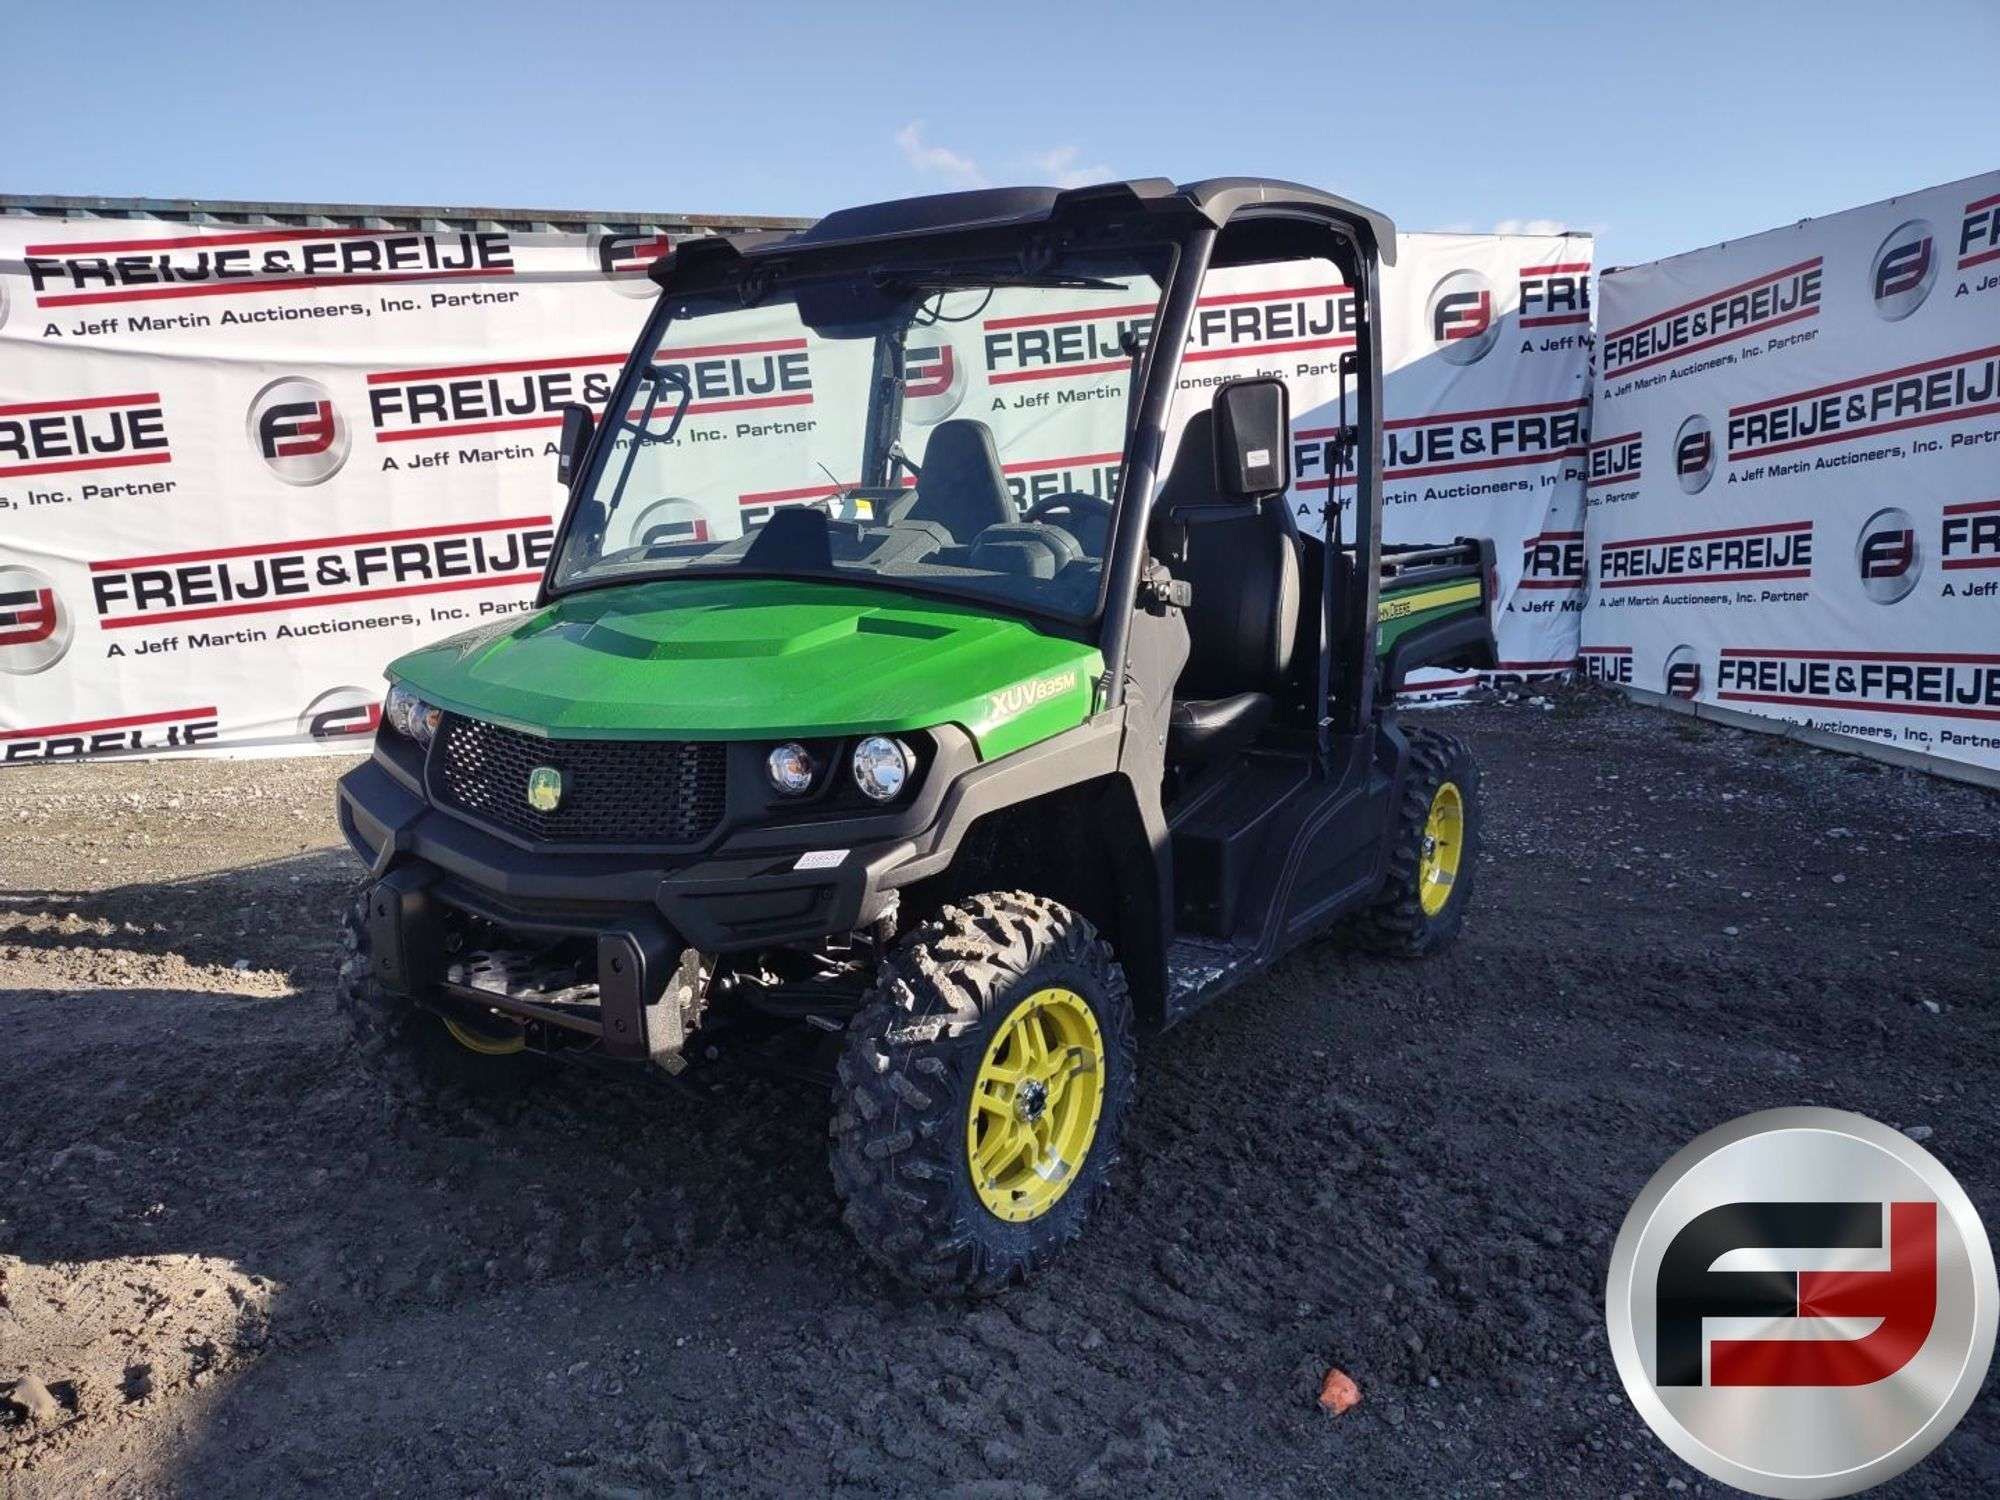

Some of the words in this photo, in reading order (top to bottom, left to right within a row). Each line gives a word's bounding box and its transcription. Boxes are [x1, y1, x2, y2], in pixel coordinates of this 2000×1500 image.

[24, 249, 254, 291] FREIJE
[302, 233, 514, 274] FREIJE
[1955, 283, 1969, 298] A
[43, 322, 63, 338] A
[72, 319, 119, 337] Jeff
[128, 312, 210, 333] Martin
[220, 303, 371, 325] Auctioneers,
[380, 298, 421, 313] Inc.
[431, 290, 519, 309] Partner
[1604, 315, 1688, 370] FREIJE
[1711, 269, 1822, 334] FREIJE
[1520, 340, 1534, 354] A
[1540, 336, 1573, 352] Jeff
[1297, 362, 1337, 377] Part
[1604, 389, 1613, 399] A
[1615, 382, 1632, 397] Jeff
[1635, 373, 1667, 393] Martin
[1670, 350, 1738, 381] Auctioneers,
[1742, 345, 1763, 360] Inc.
[1768, 329, 1819, 352] Partner
[368, 373, 576, 428] FREIJE
[630, 353, 812, 404] REIJE
[991, 398, 1006, 411] A
[1014, 394, 1050, 408] Jeff
[1057, 386, 1121, 405] Martin
[1728, 396, 1842, 450] FREIJE
[1870, 360, 2000, 422] FREIJ
[382, 457, 399, 471] A
[408, 453, 450, 469] Jeff
[459, 445, 534, 464] Martin
[690, 428, 728, 443] Inc.
[736, 420, 817, 438] Partner
[1295, 427, 1454, 477] FRIJE
[1592, 442, 1642, 477] EIJE
[1728, 472, 1738, 483] A
[1741, 468, 1764, 482] Jeff
[1768, 461, 1810, 477] Martin
[1815, 447, 1906, 470] Auctioneers,
[1913, 440, 1943, 454] Inc.
[28, 491, 72, 505] Inc.
[82, 481, 177, 500] Partner
[1297, 503, 1310, 515] A
[1382, 491, 1417, 506] rtin
[1424, 479, 1534, 501] Auctioneers,
[1605, 491, 1640, 504] Partner
[92, 556, 310, 614] FREIJE
[316, 555, 350, 586] &
[354, 530, 554, 586] FREIJE
[1600, 546, 1684, 579] FREIJE
[1706, 534, 1812, 571] FREIJE
[1522, 600, 1555, 613] Jeff
[1627, 594, 1659, 607] Martin
[1662, 593, 1732, 606] Auctioneers,
[1736, 592, 1756, 604] Inc.
[1761, 591, 1809, 603] Partner
[1941, 583, 1955, 597] A
[1962, 582, 1998, 597] Jeff
[107, 643, 125, 658] A
[134, 637, 179, 656] Jeff
[188, 628, 267, 649] Martin
[276, 613, 421, 640] Auctioneers,
[431, 608, 470, 622] Inc.
[1718, 660, 1830, 695] FREIJE
[1905, 727, 1932, 743] Inc.
